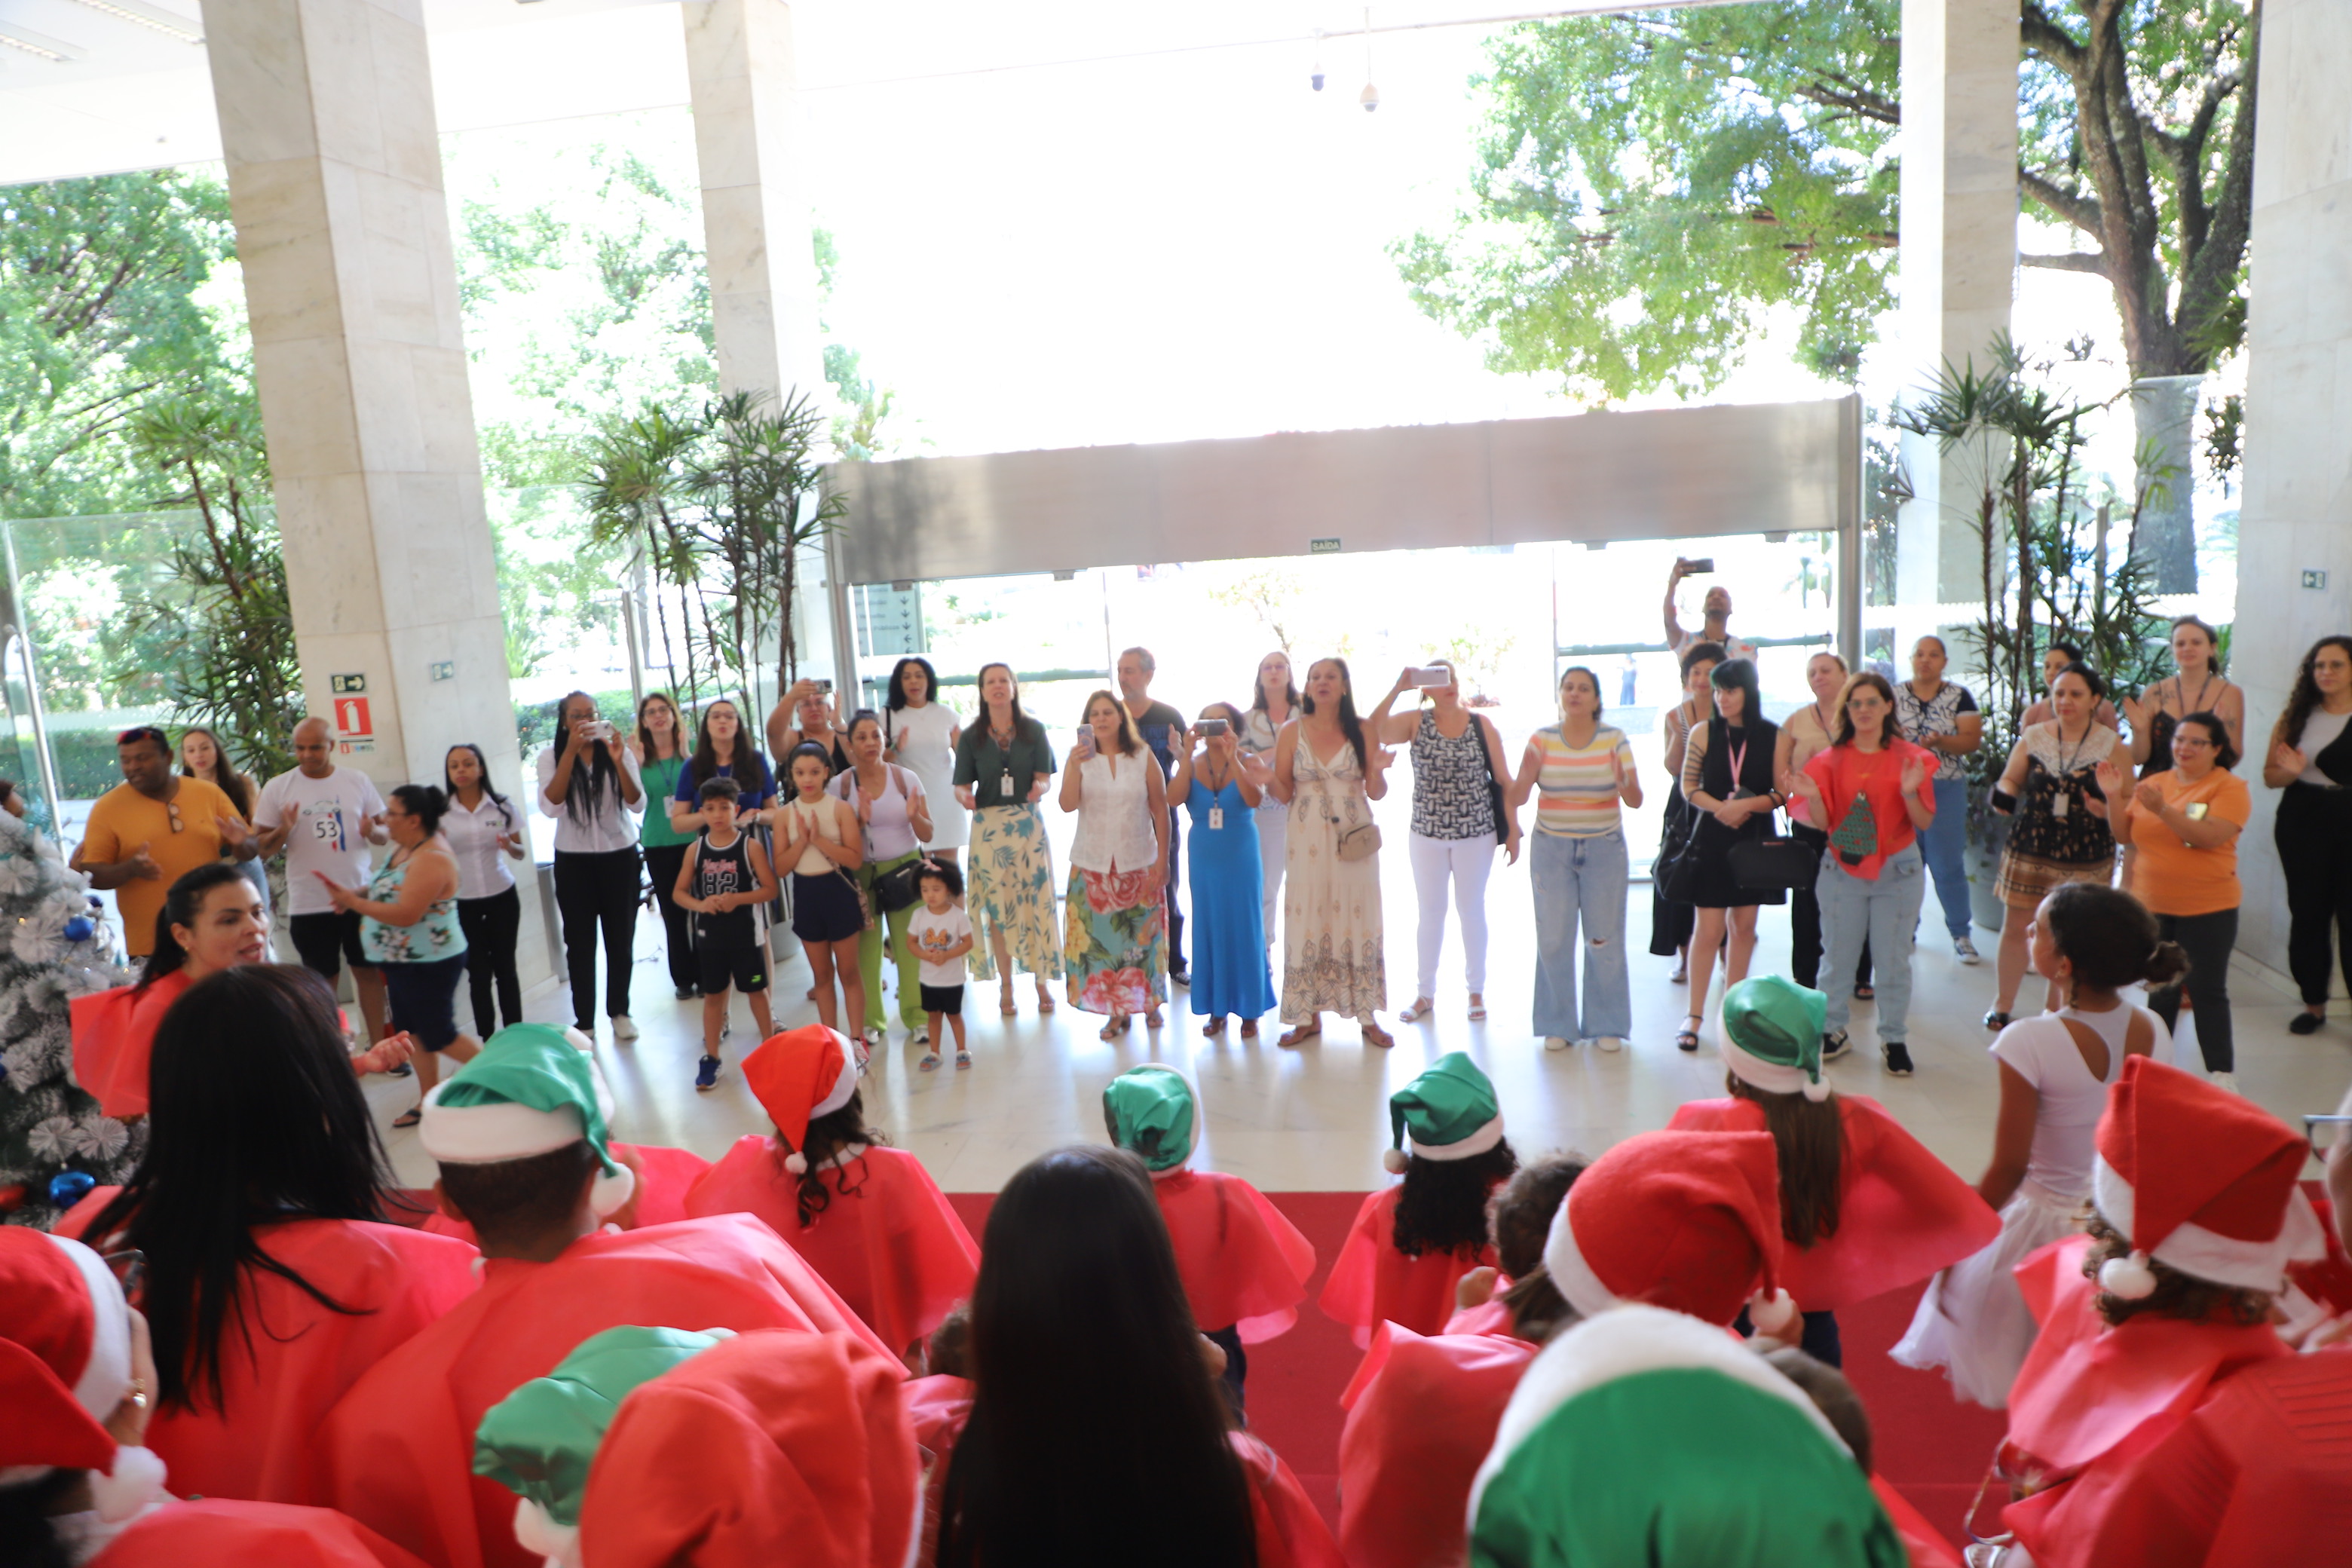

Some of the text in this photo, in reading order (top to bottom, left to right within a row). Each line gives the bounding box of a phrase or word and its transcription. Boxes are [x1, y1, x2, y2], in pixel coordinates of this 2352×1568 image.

[1312, 541, 1340, 550] SAÍDA
[316, 821, 338, 838] 53
[702, 870, 738, 897] 82
